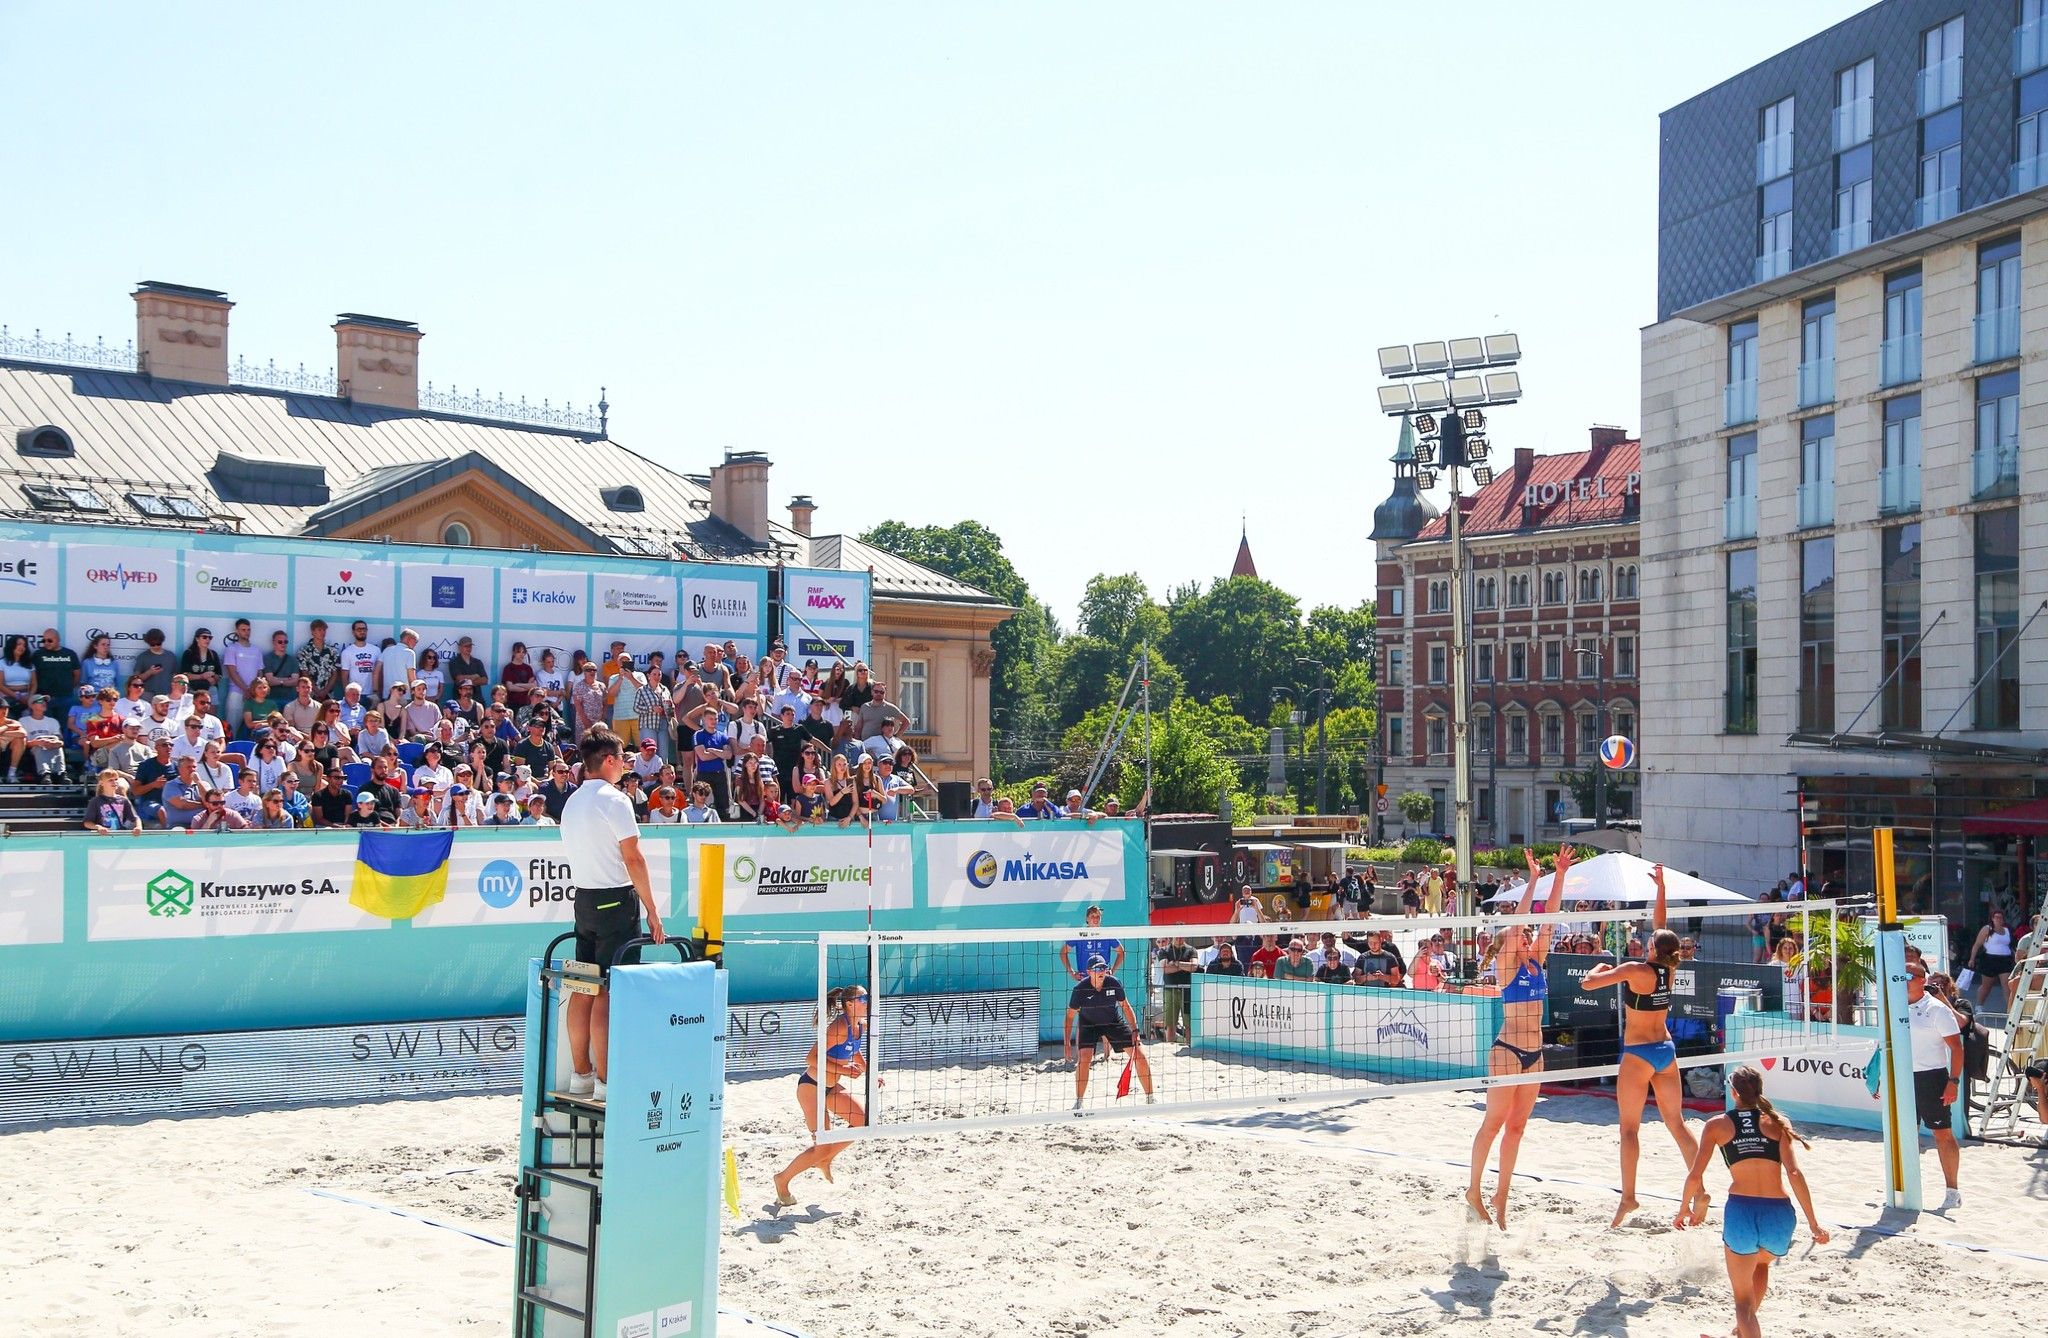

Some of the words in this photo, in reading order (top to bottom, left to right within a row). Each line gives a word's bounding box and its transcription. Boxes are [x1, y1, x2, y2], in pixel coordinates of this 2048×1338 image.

[1524, 477, 1611, 507] HOTEL
[327, 585, 364, 597] Love
[532, 590, 576, 605] Kraków
[711, 598, 747, 611] GALERIA
[806, 643, 821, 651] TVP
[529, 859, 572, 880] fitn
[759, 865, 870, 884] PakarService
[201, 881, 296, 900] Kruszywo
[301, 879, 340, 895] S.A.
[482, 875, 519, 898] my
[529, 881, 576, 908] plac
[1674, 978, 1690, 986] CEV
[677, 1013, 705, 1026] Senoh
[901, 998, 1025, 1026] SWING
[1252, 1003, 1292, 1021] GALERIA
[352, 1025, 517, 1061] SWING
[12, 1043, 207, 1082] SWING
[1782, 1056, 1834, 1076] Love
[647, 1110, 663, 1118] BEACH
[680, 1112, 691, 1120] CEV
[1742, 1118, 1753, 1127] 2
[656, 1141, 683, 1153] KRAKOW
